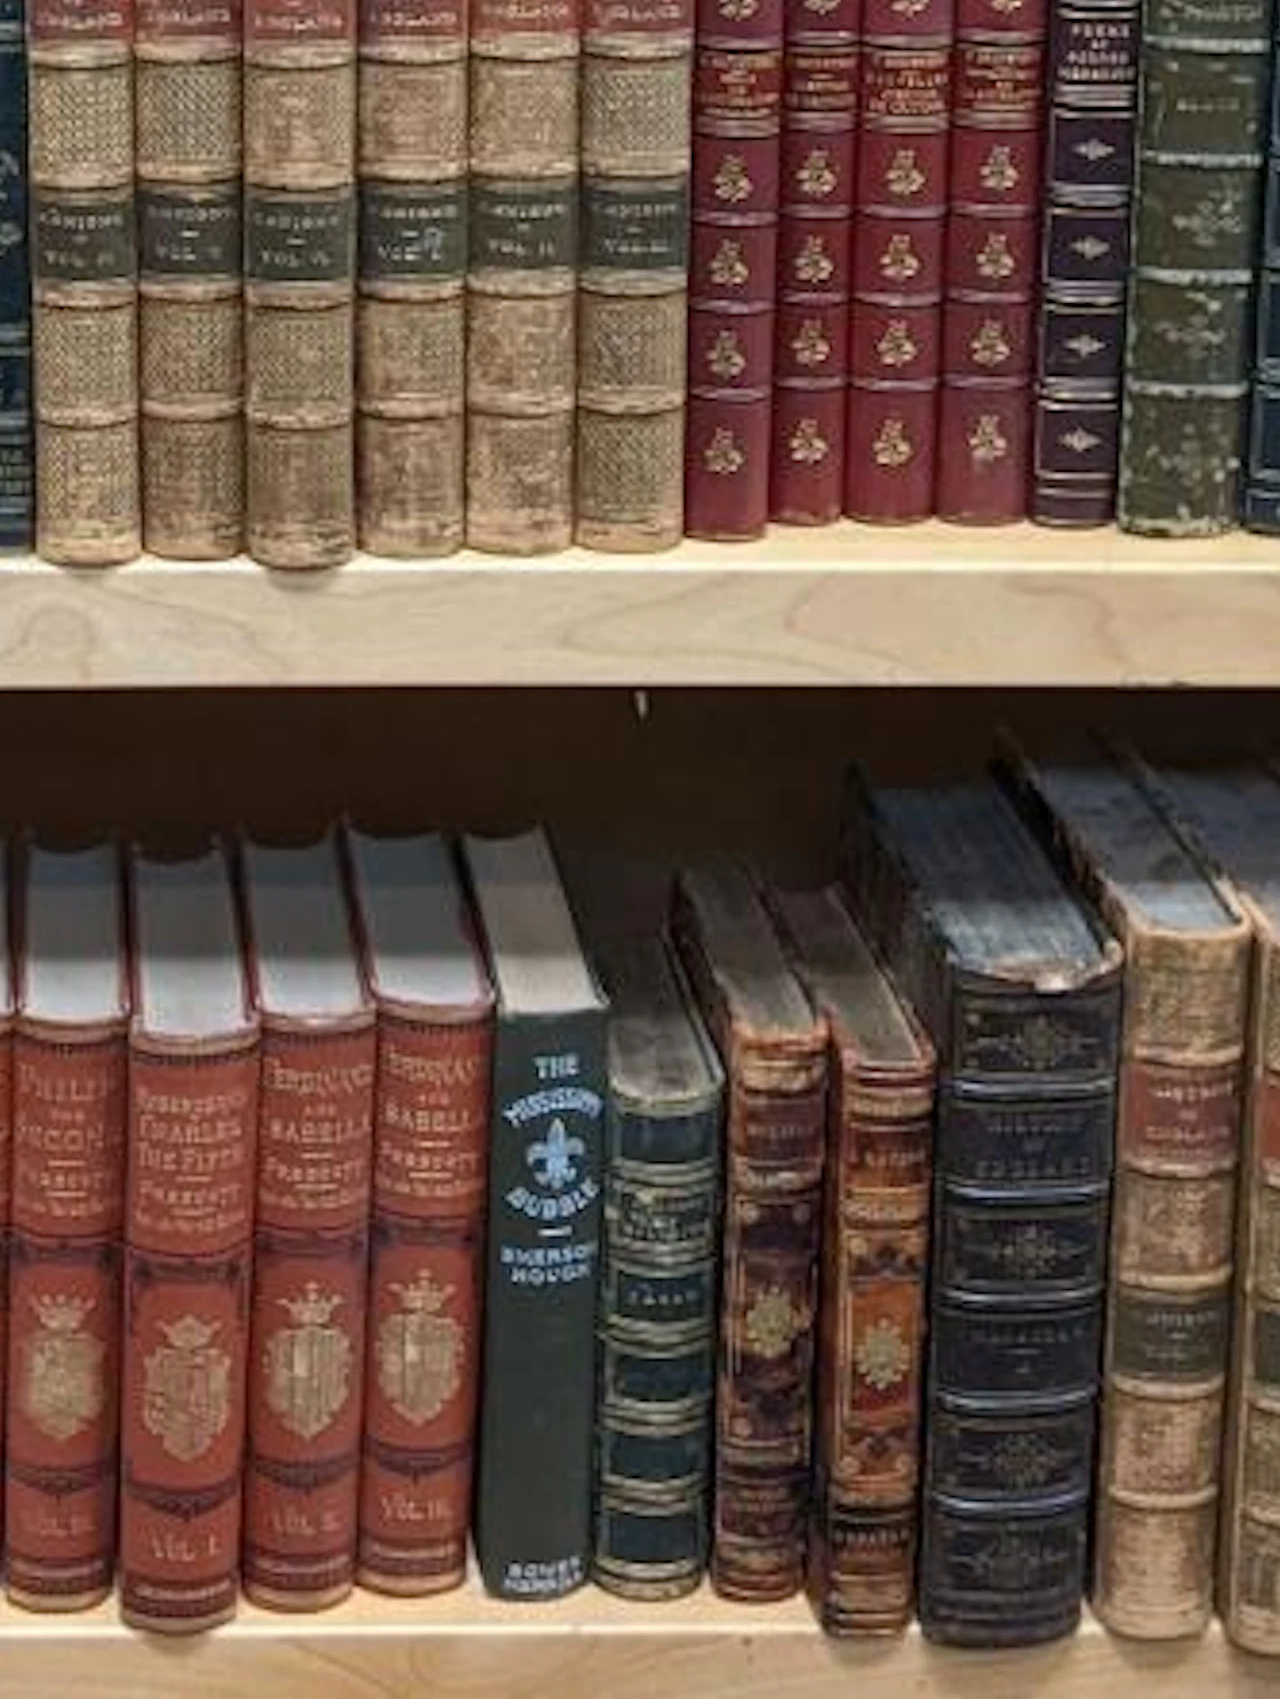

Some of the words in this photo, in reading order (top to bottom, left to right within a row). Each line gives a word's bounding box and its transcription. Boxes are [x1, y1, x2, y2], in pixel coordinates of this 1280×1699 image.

[533, 1054, 579, 1078] THE
[503, 1087, 604, 1127] MISSISSIPPI
[504, 1177, 602, 1220] BUBBLE
[511, 1262, 592, 1285] HOUGH
